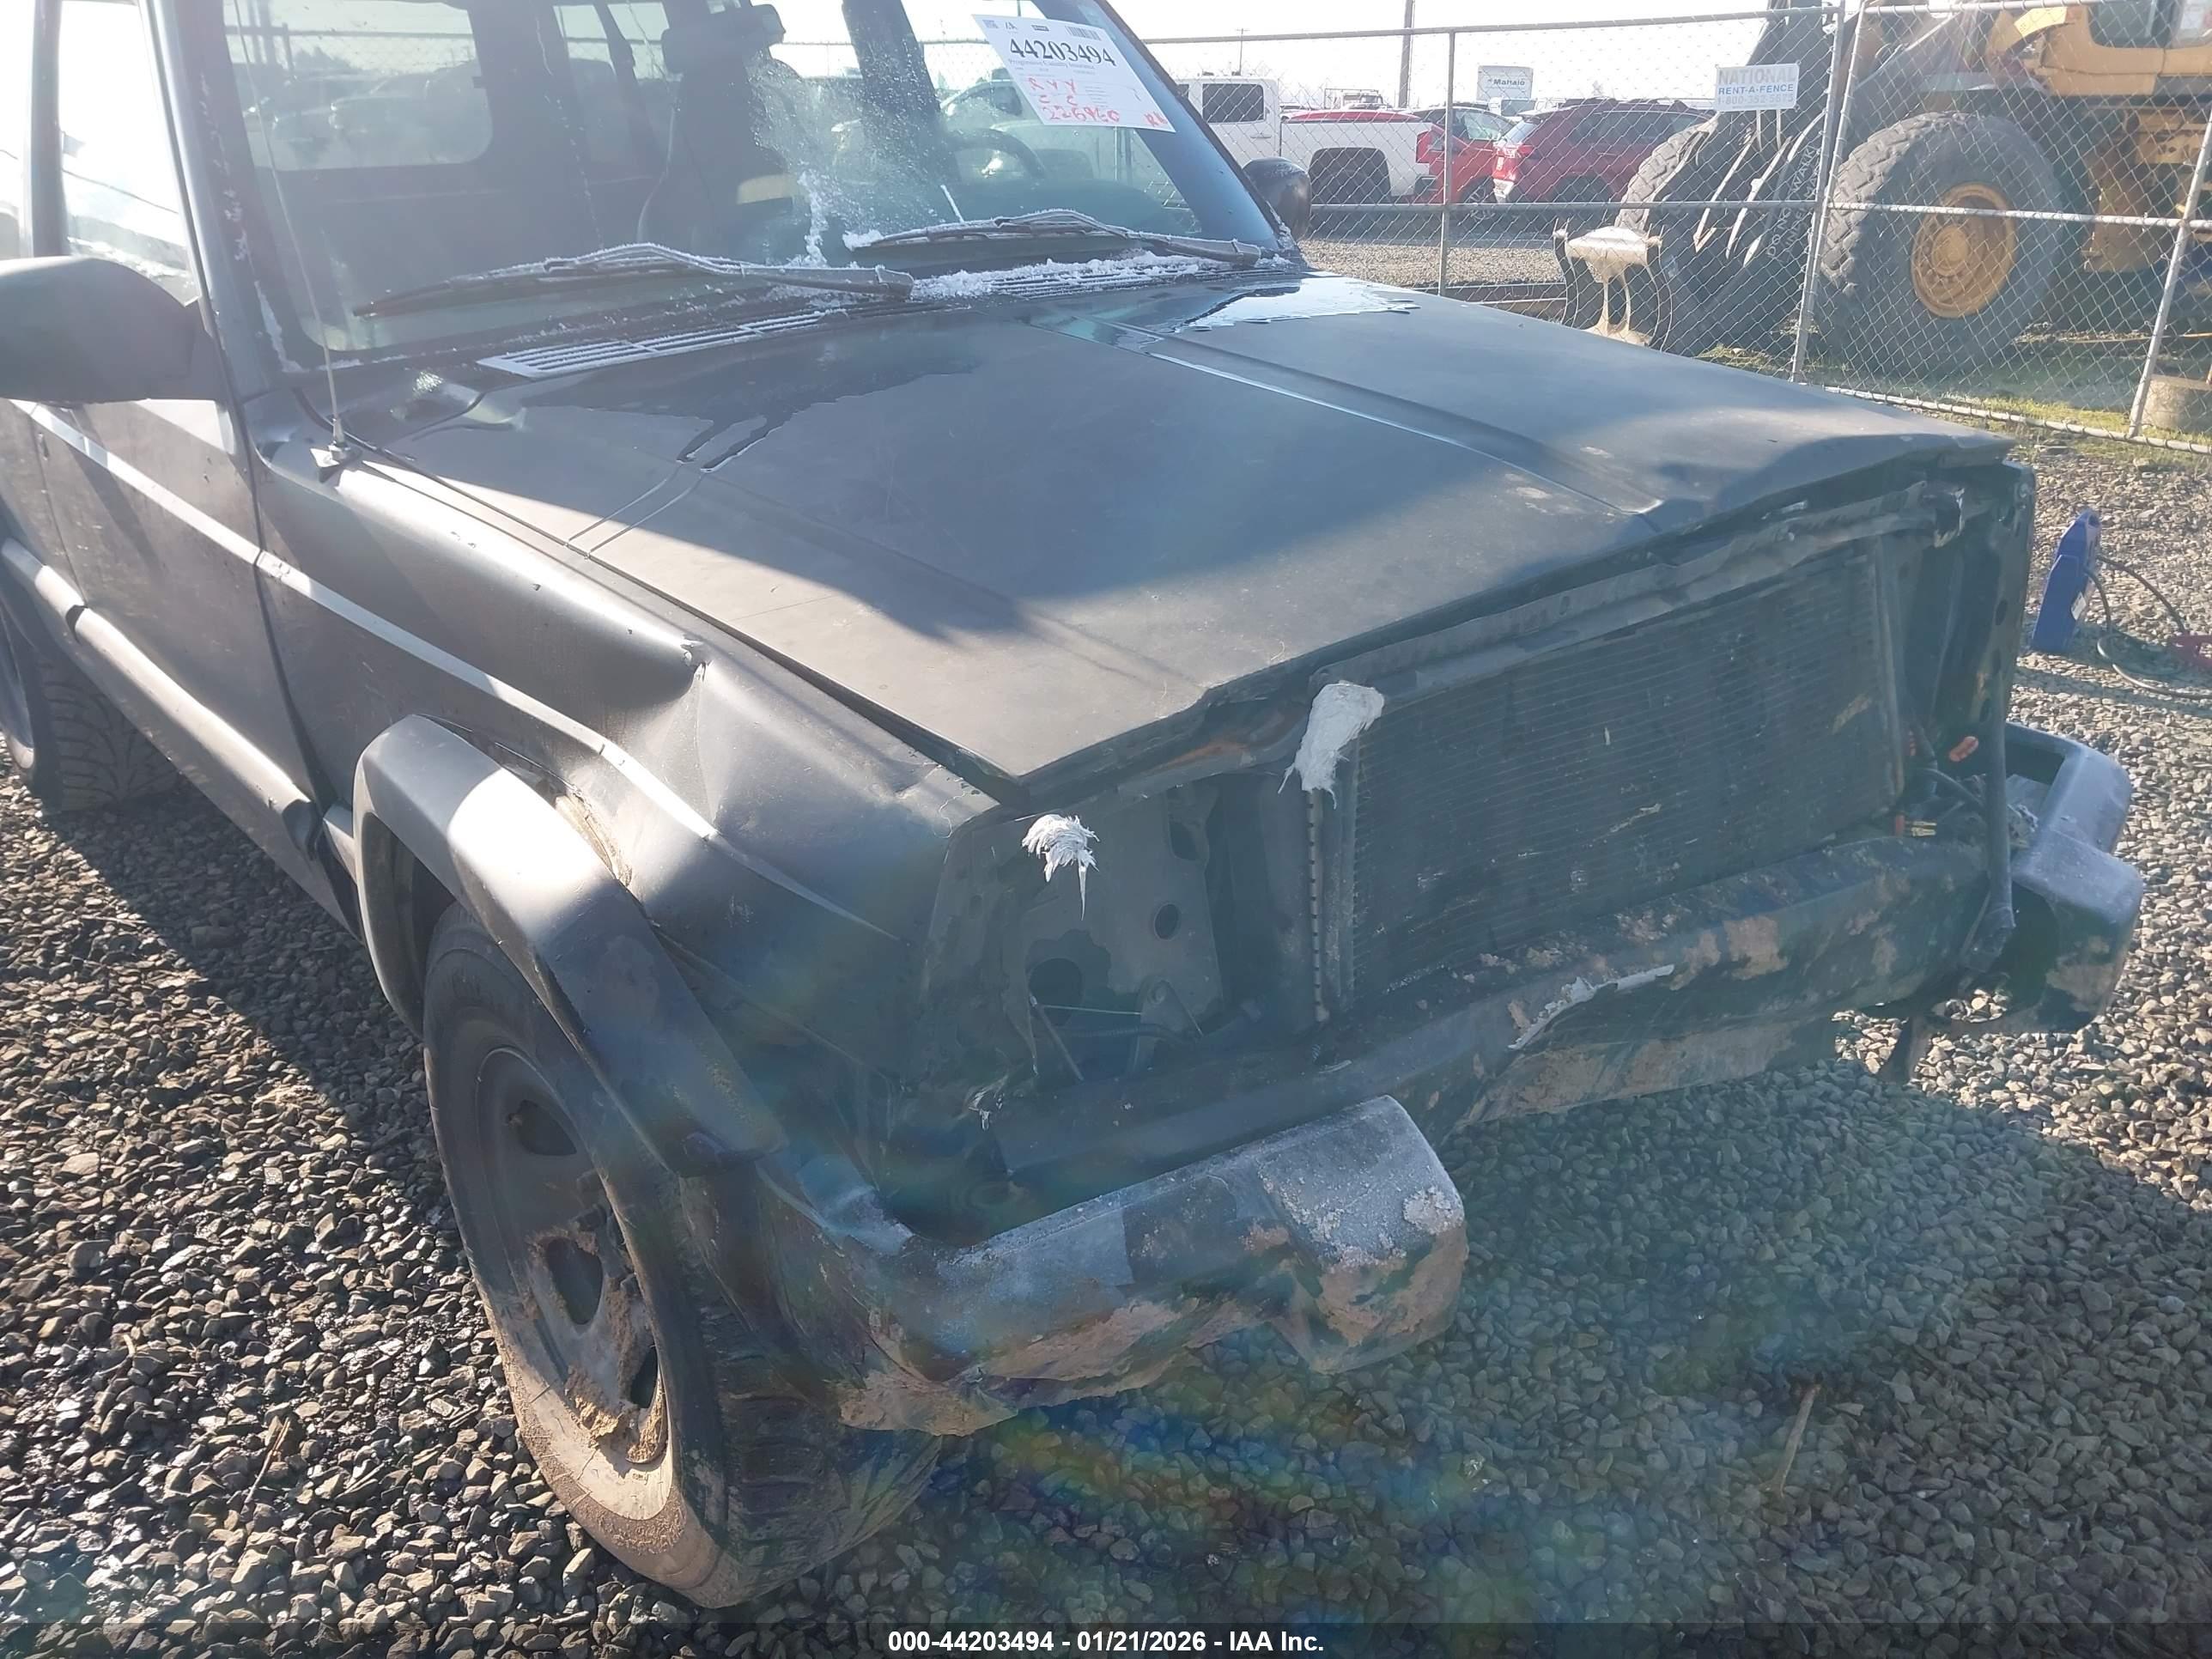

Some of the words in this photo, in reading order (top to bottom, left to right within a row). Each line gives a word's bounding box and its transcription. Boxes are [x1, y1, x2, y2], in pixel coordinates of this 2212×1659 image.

[1009, 38, 1117, 68] 44203494
[1718, 68, 1796, 86] NATIONAL
[1718, 83, 1794, 95] RENT-A-FENCE
